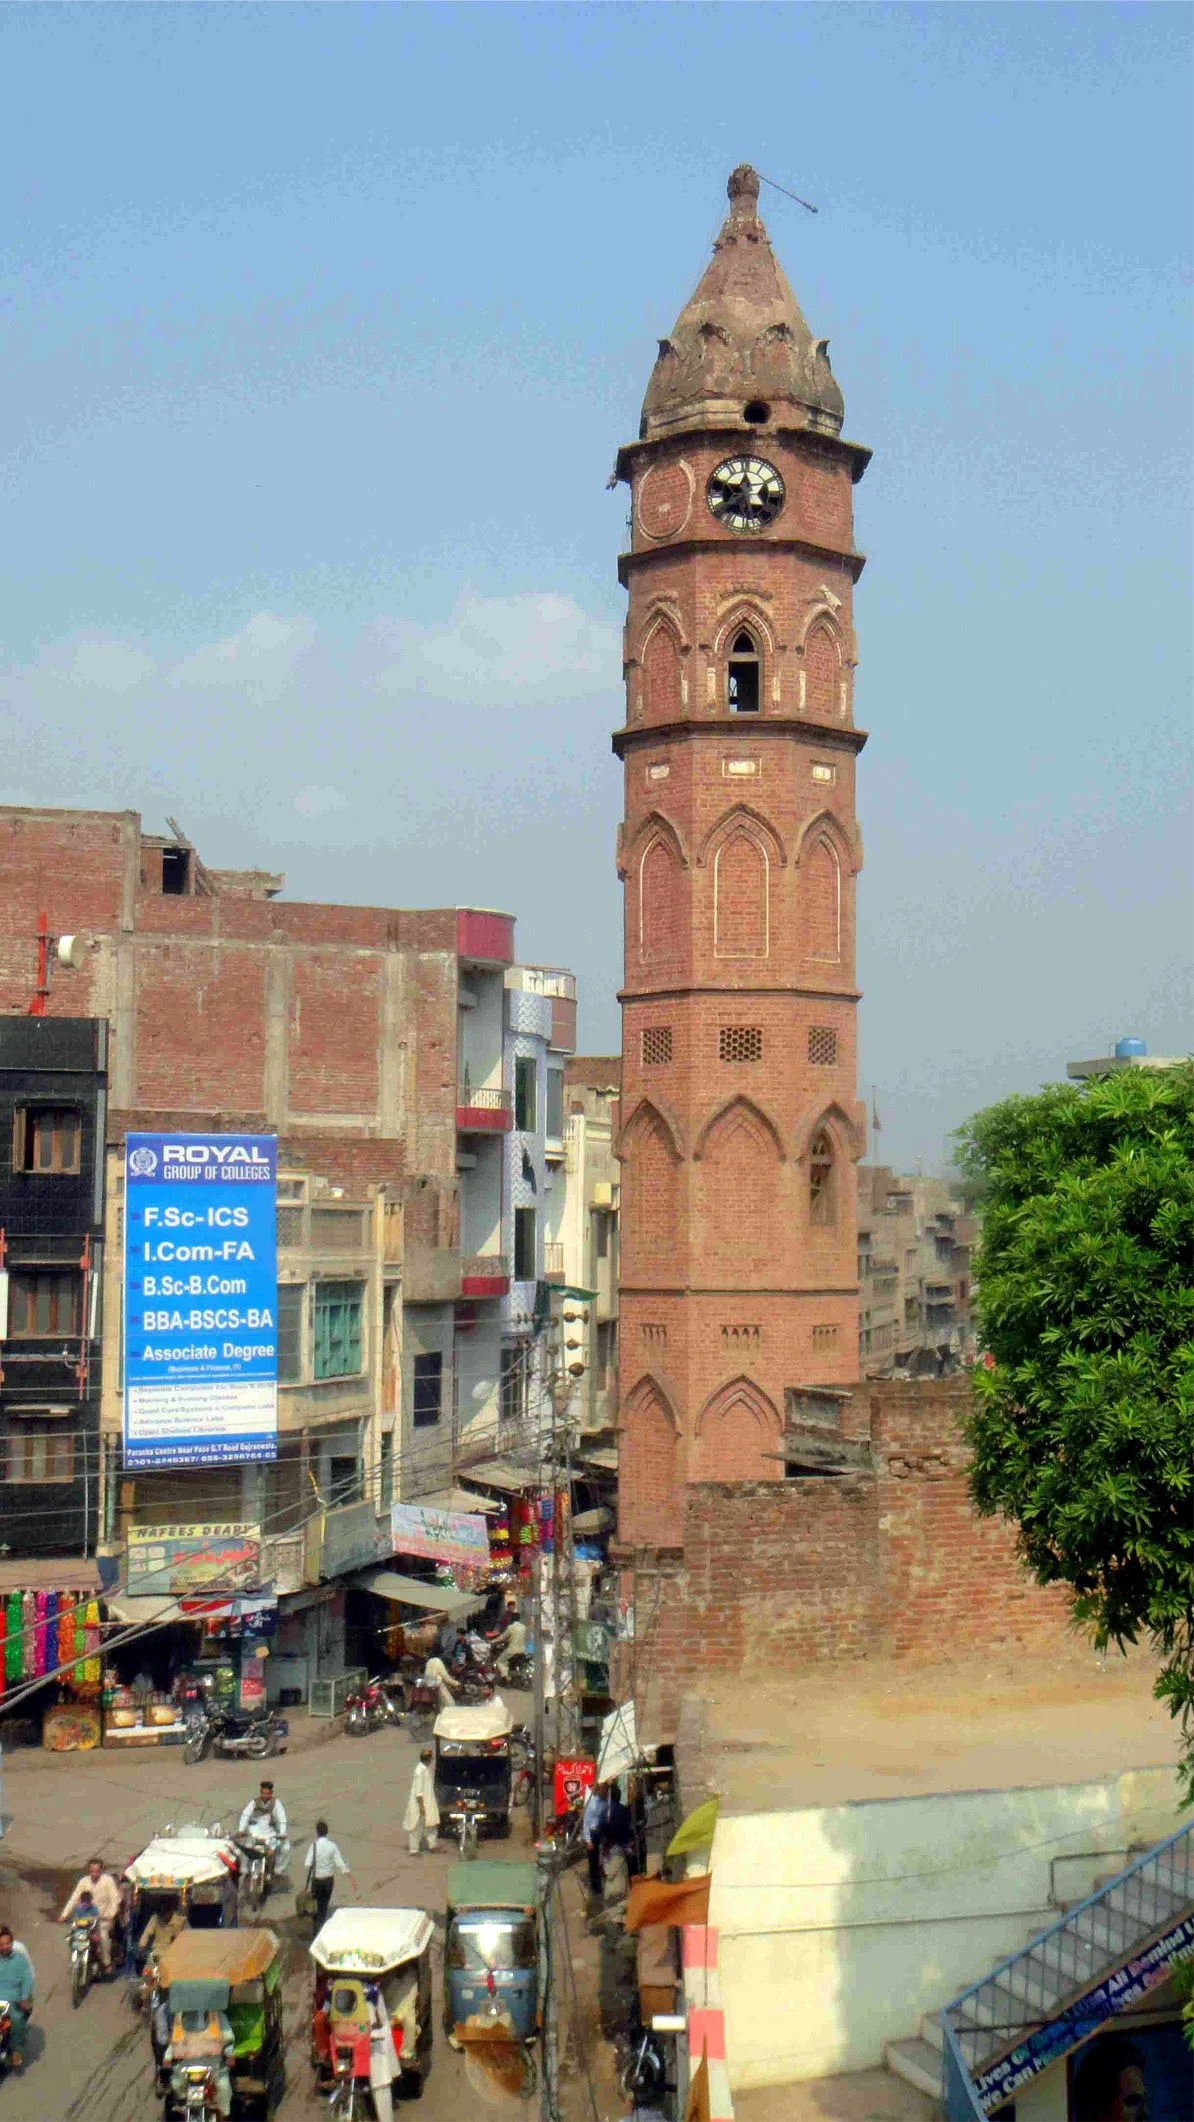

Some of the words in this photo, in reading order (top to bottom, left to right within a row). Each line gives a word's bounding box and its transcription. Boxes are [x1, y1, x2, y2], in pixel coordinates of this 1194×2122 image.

[163, 1145, 269, 1163] ROYAL
[163, 1166, 202, 1180] GROUP
[205, 1166, 218, 1180] OF
[221, 1166, 271, 1180] COLLEGES
[144, 1241, 255, 1262] I.Com-FA
[143, 1275, 246, 1296] B.Sc-B.Com
[143, 1309, 273, 1331] BBA-BSCS-BA
[142, 1344, 217, 1361] Associate
[223, 1342, 274, 1361] Degree
[137, 1526, 196, 1537] NAFEES
